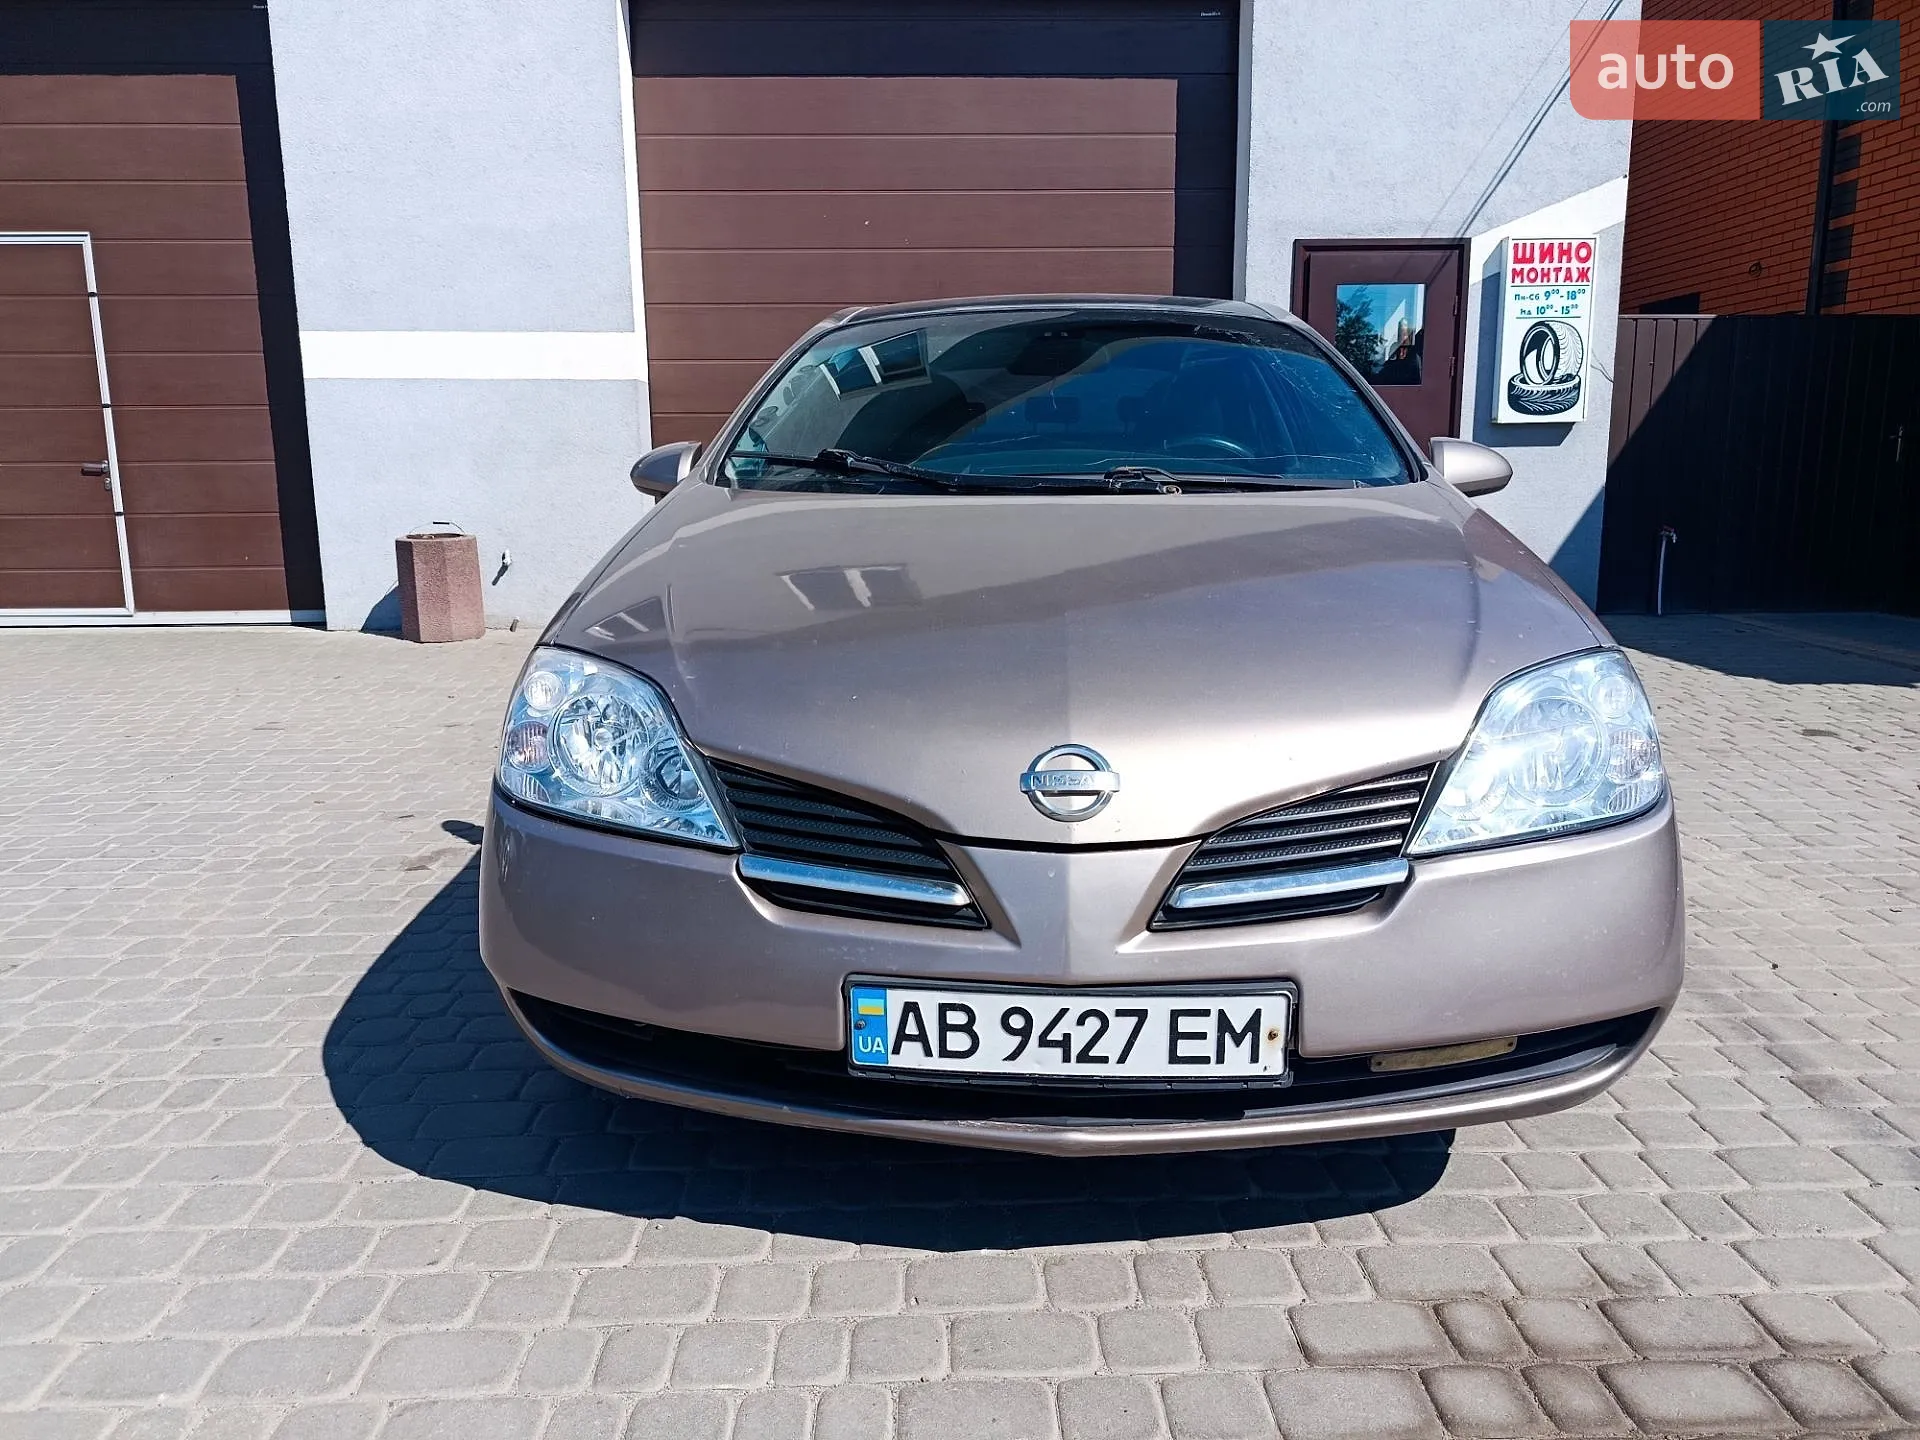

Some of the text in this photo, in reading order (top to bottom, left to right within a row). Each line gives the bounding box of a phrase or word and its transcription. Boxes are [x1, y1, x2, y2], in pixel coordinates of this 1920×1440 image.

[1512, 241, 1592, 264] ШИНО
[1511, 266, 1591, 284] МОНТАЖ
[1030, 773, 1108, 788] NISSA
[890, 1001, 1263, 1065] AB 9427 EM
[858, 1036, 886, 1054] UA
